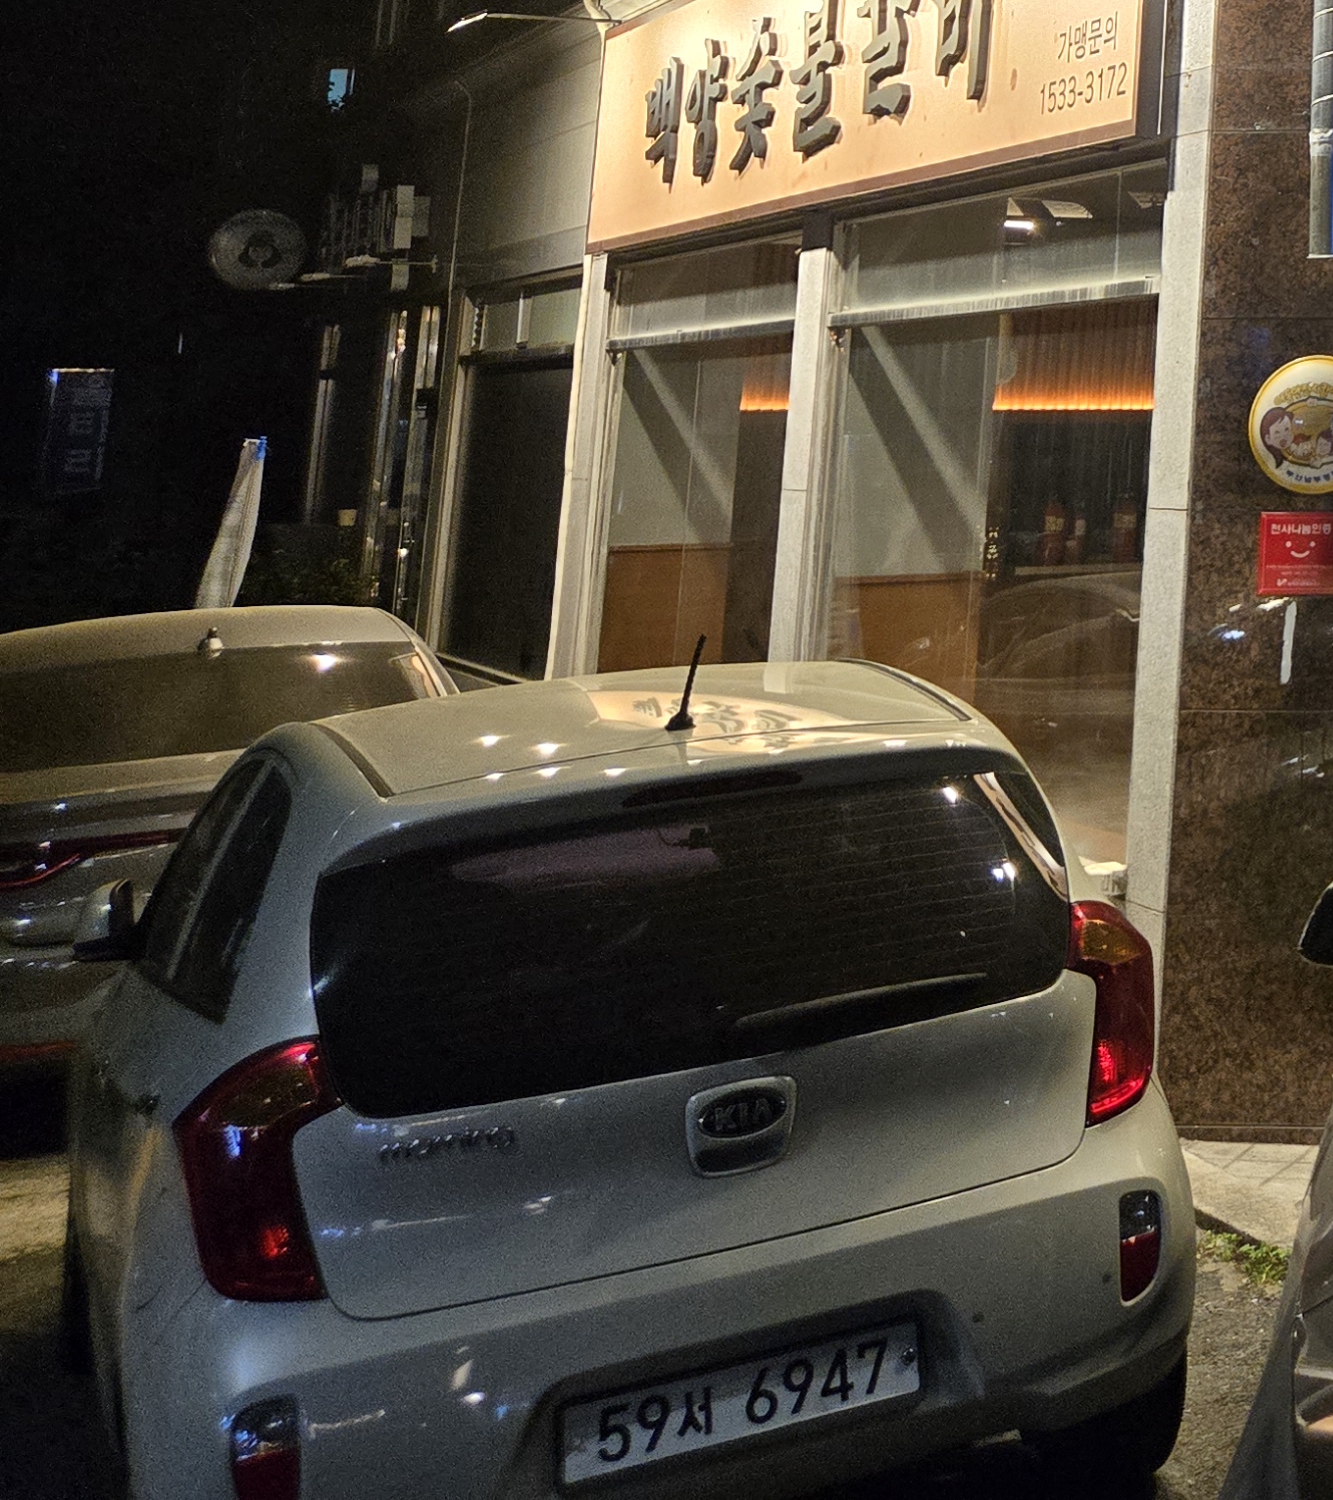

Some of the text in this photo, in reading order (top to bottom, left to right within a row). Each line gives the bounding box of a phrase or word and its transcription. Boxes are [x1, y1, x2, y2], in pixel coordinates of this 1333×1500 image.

[1057, 10, 1119, 64] 가맹문의
[1039, 61, 1128, 116] 1533-3172
[598, 1337, 889, 1463] 59서 6947
